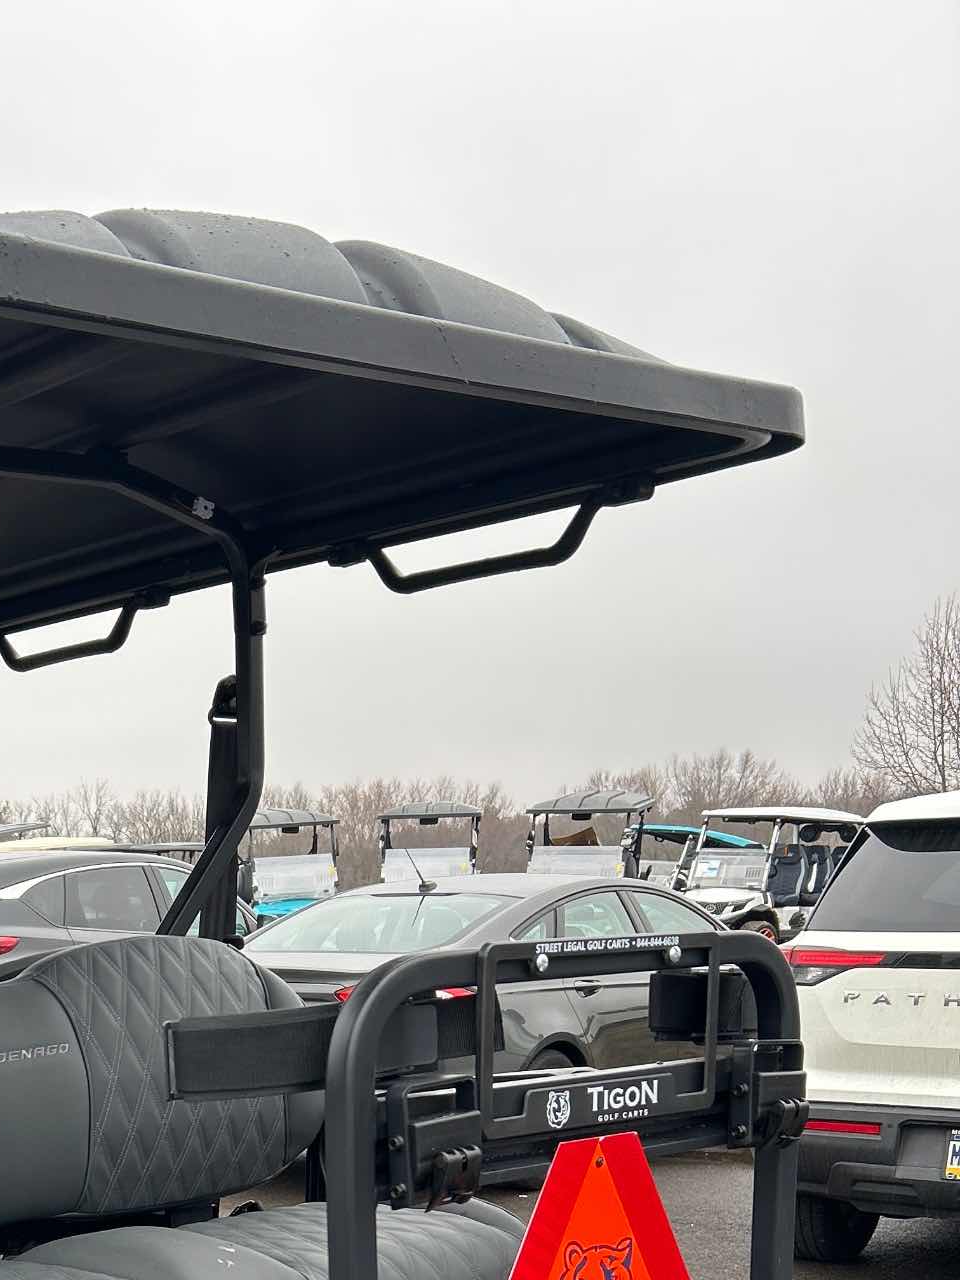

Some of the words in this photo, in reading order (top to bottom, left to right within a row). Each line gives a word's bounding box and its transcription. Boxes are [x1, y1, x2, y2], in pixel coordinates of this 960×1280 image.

[535, 942, 562, 953] STREET
[563, 941, 586, 952] LEGAL
[587, 939, 606, 951] GOLF
[607, 938, 630, 949] CARTS
[587, 1080, 658, 1111] TIGON
[598, 1112, 619, 1122] GOLF
[622, 1109, 649, 1119] CARTS
